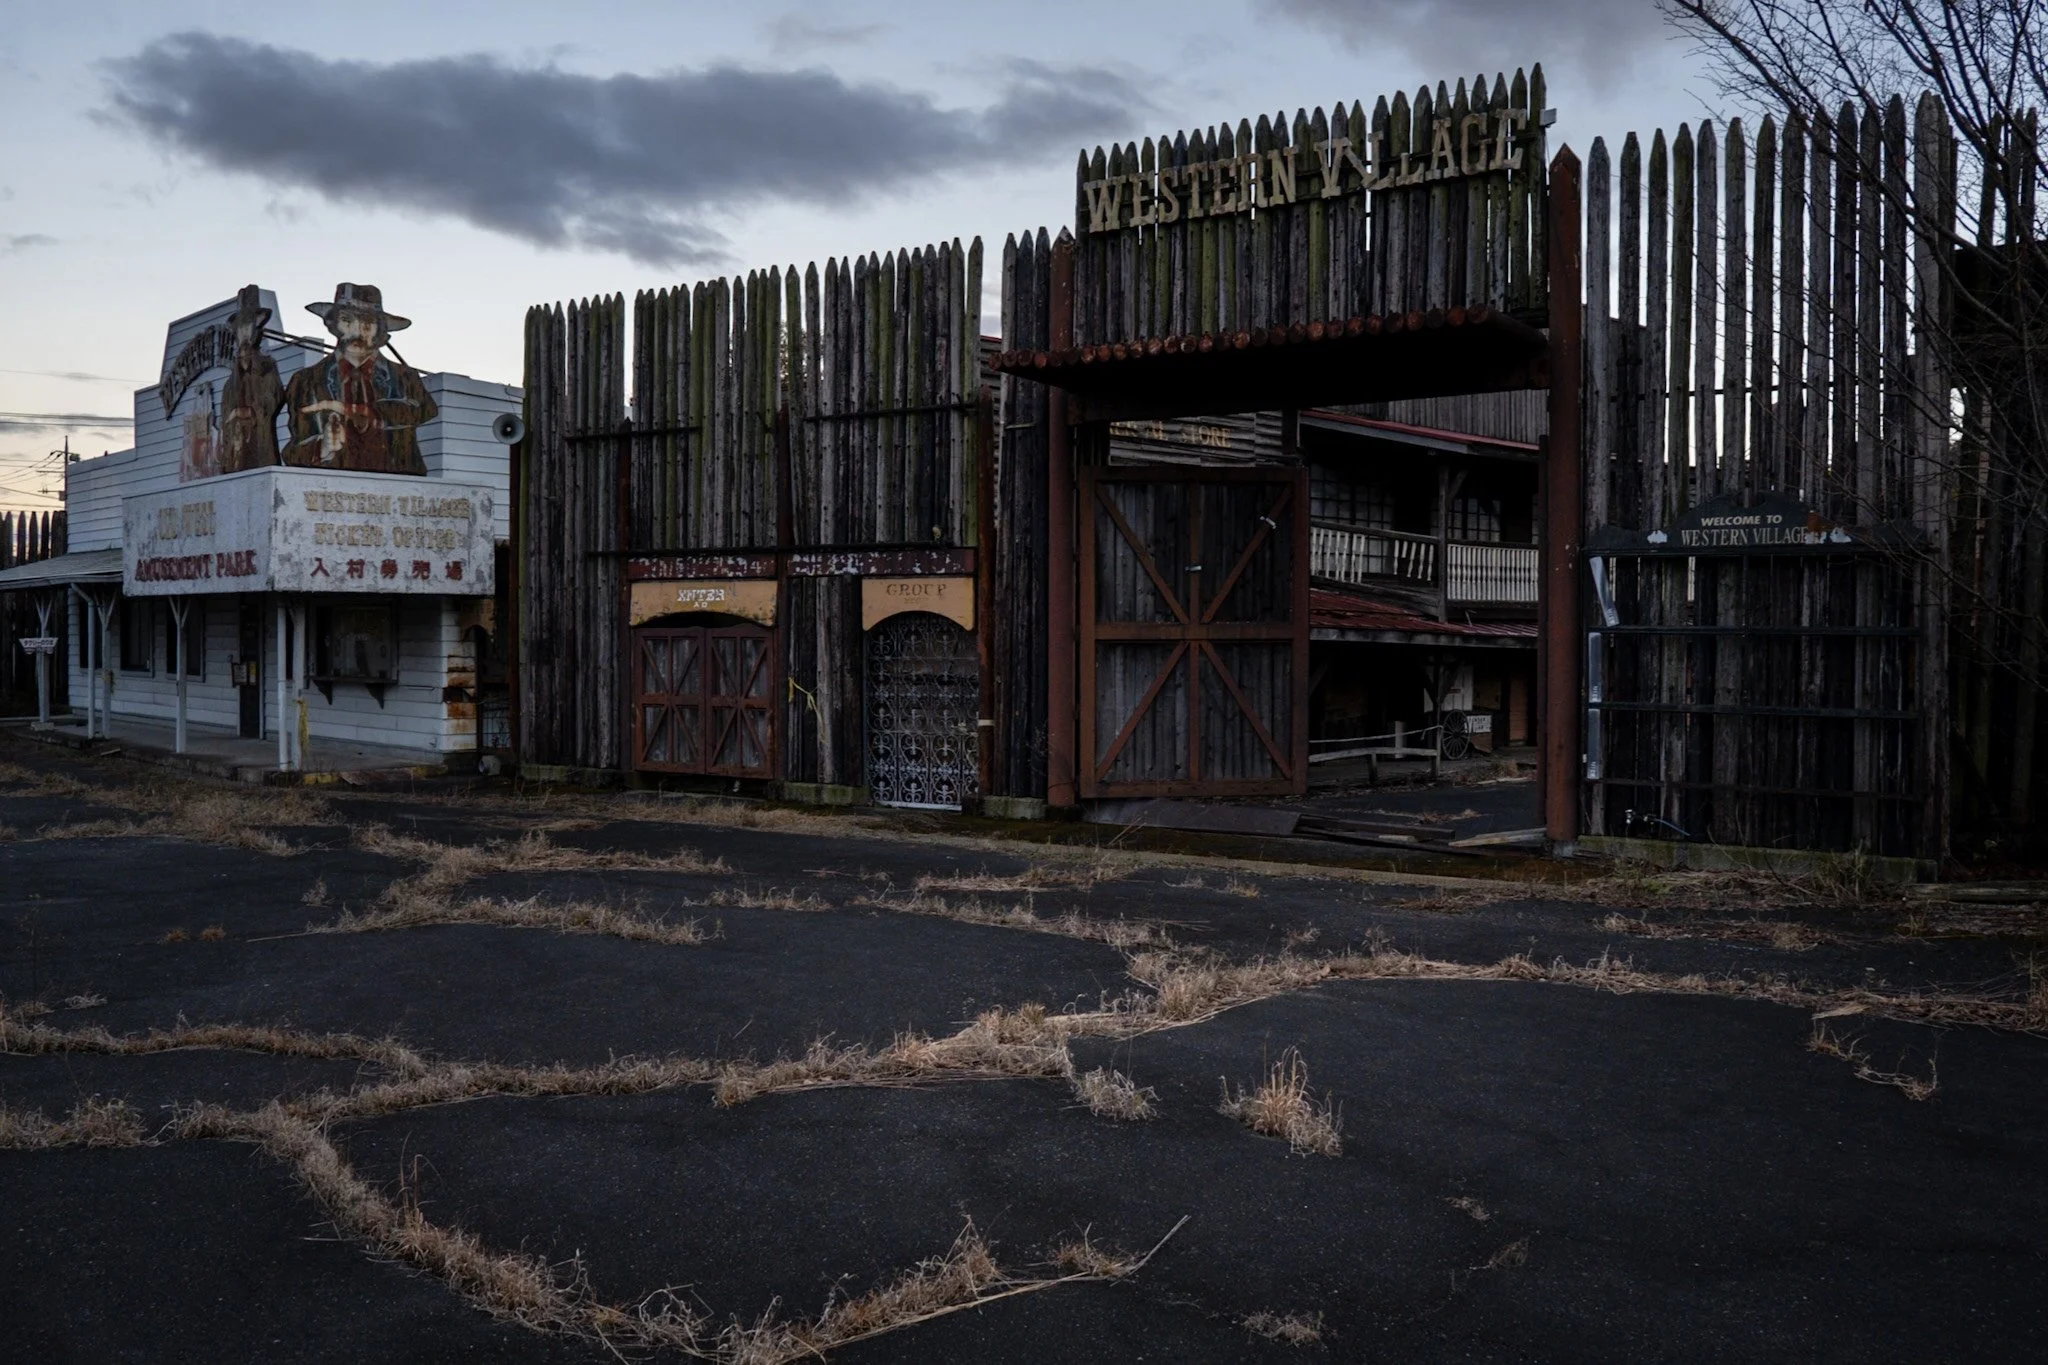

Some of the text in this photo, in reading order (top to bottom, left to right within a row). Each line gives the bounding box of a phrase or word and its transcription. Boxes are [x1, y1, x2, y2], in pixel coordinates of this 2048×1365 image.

[1083, 145, 1299, 233] WESTERN
[304, 490, 470, 519] WESTERN VILLAGE
[1701, 514, 1783, 527] WELCOME TO
[314, 523, 383, 546] TICKET
[1681, 526, 1808, 547] WESTERN VILLAGE
[135, 550, 257, 581] AMUSEMENT PARK
[311, 557, 463, 581] 入村券売場
